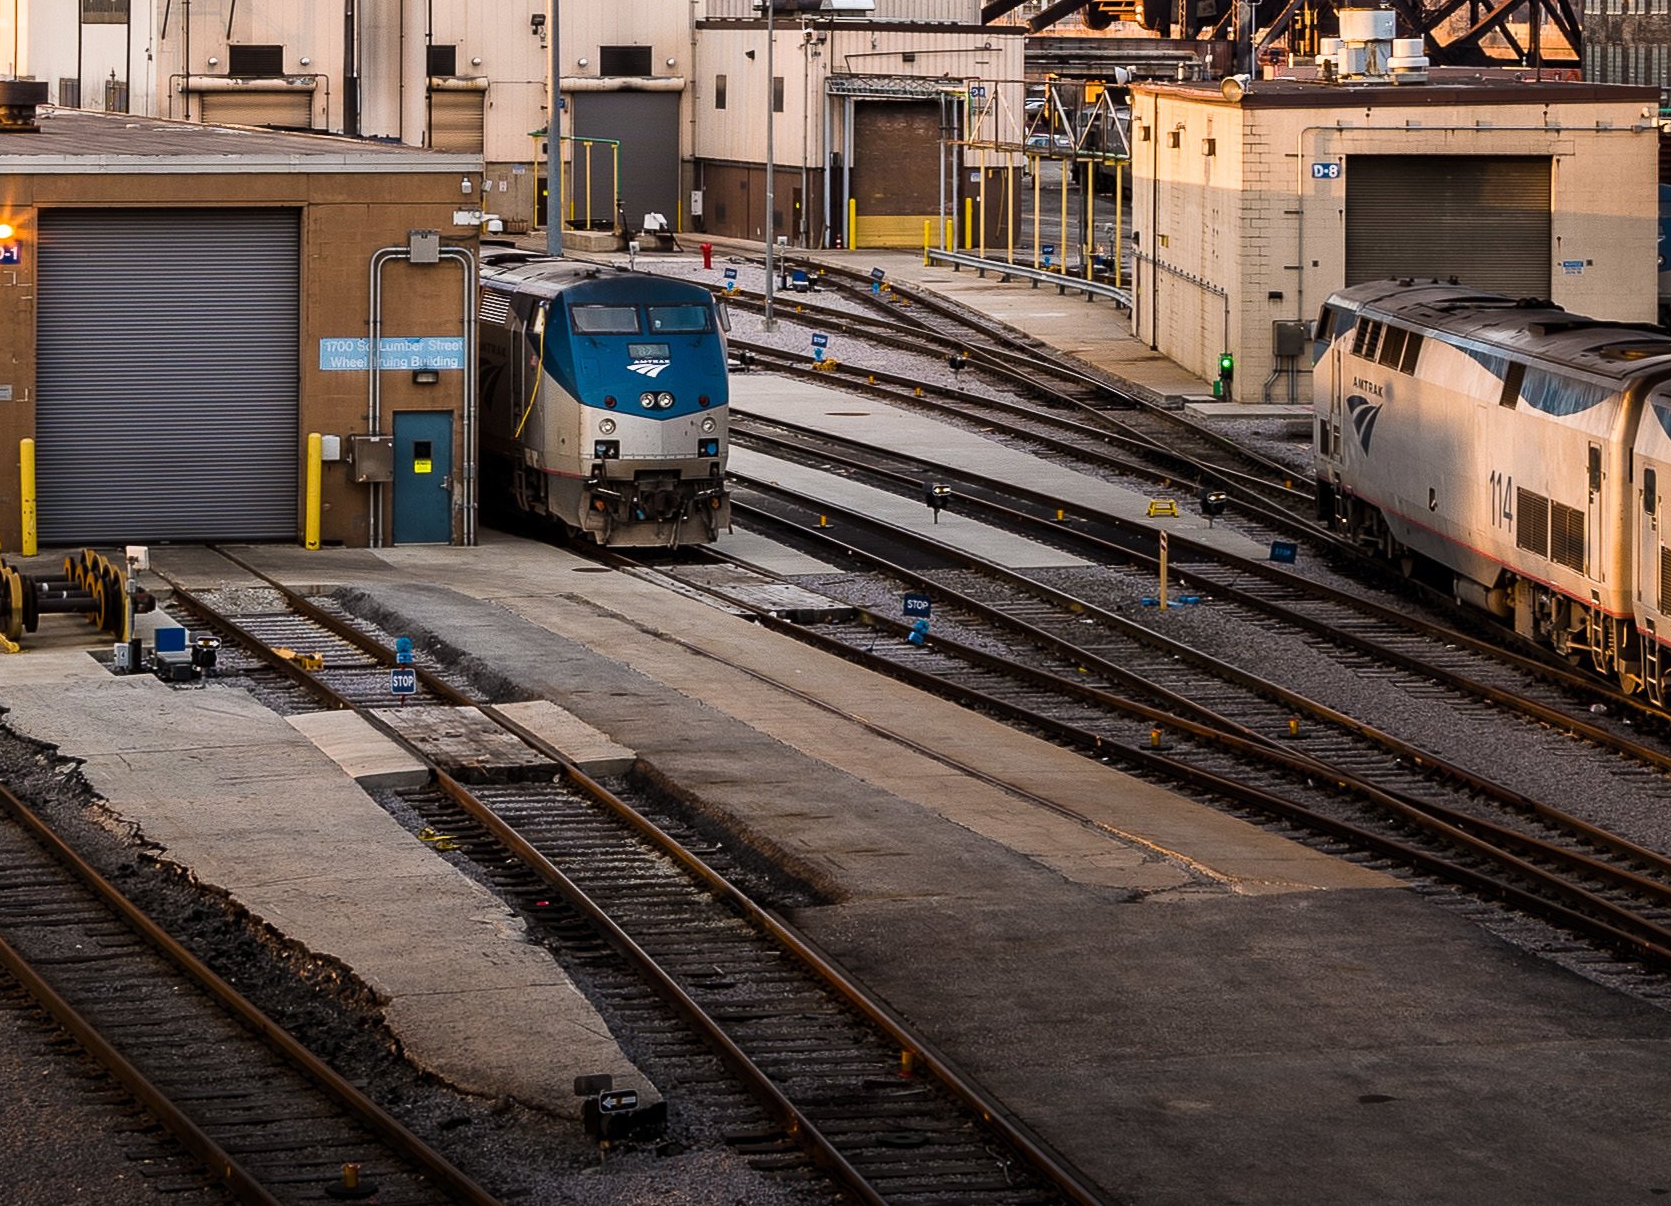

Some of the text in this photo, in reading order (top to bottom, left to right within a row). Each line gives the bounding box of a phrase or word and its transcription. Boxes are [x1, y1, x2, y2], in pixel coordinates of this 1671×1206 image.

[1313, 165, 1338, 178] D-8
[326, 342, 353, 352] 1700
[380, 341, 424, 351] Lumber
[428, 340, 464, 351] Street
[330, 356, 368, 367] Wheel
[411, 356, 458, 367] Building
[1353, 376, 1384, 397] AMTRAK
[1488, 470, 1513, 534] 114
[907, 599, 929, 610] STOP
[393, 675, 414, 687] STOP
